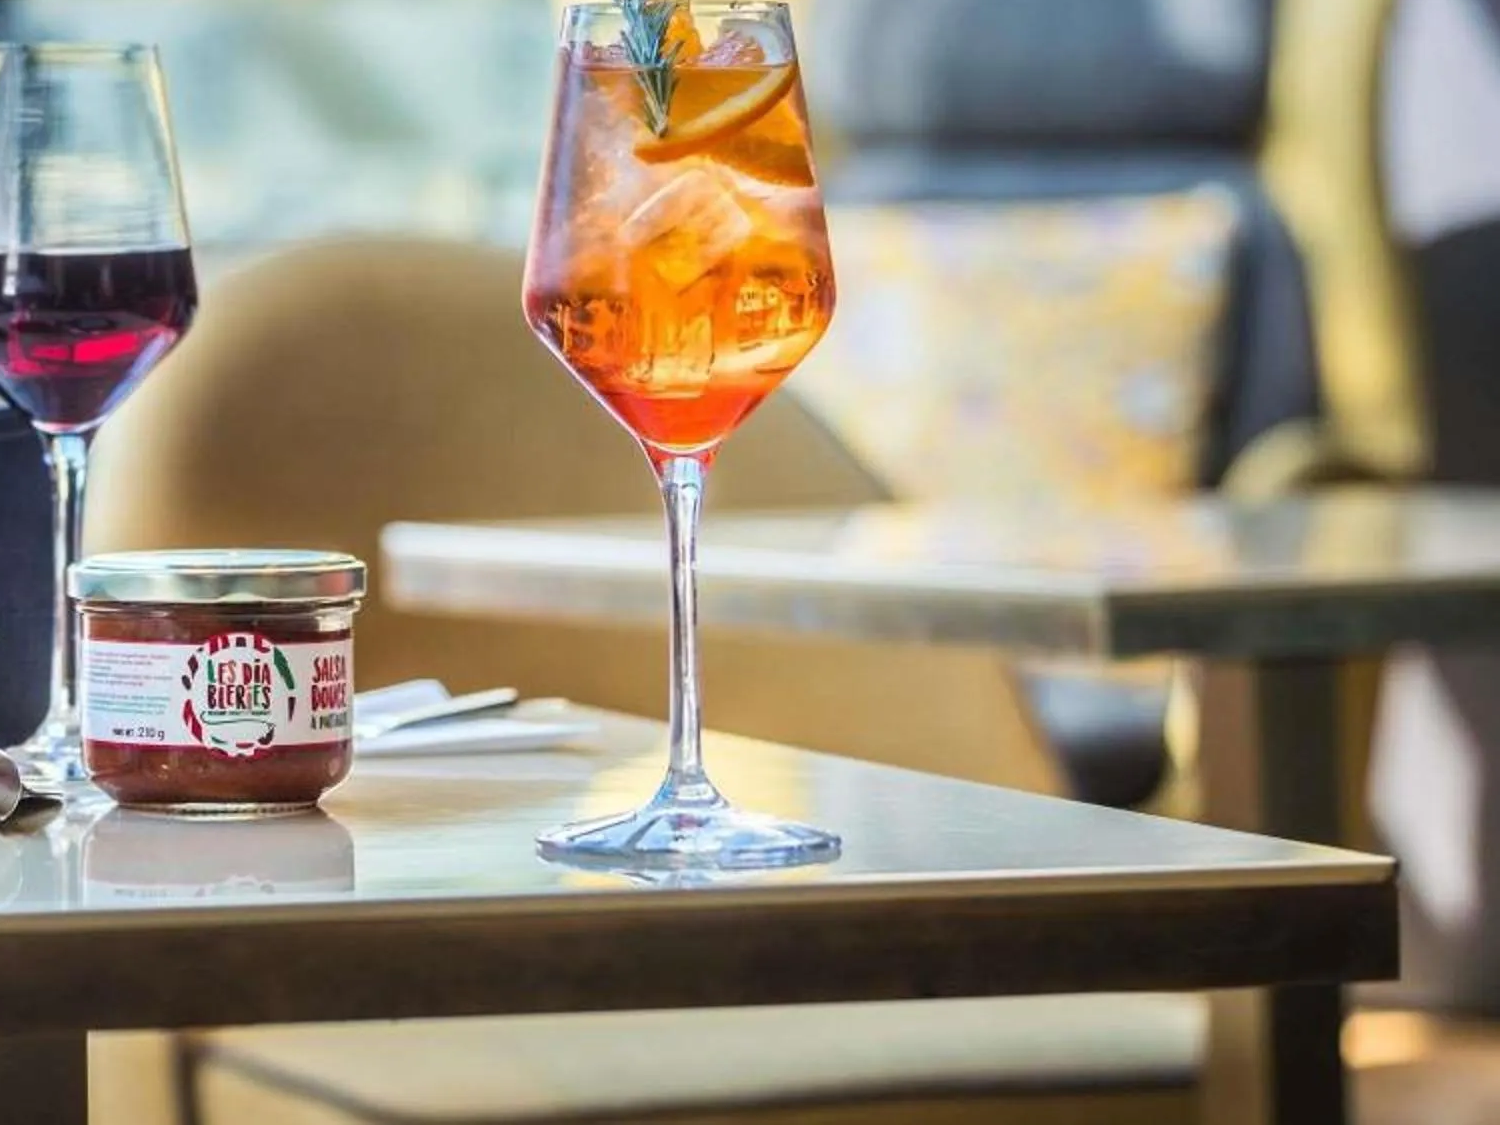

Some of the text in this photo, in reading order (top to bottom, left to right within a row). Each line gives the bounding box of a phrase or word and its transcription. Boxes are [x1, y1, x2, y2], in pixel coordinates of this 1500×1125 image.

[207, 659, 236, 684] LES
[312, 654, 347, 683] SALSA
[311, 682, 347, 711] DOUCE
